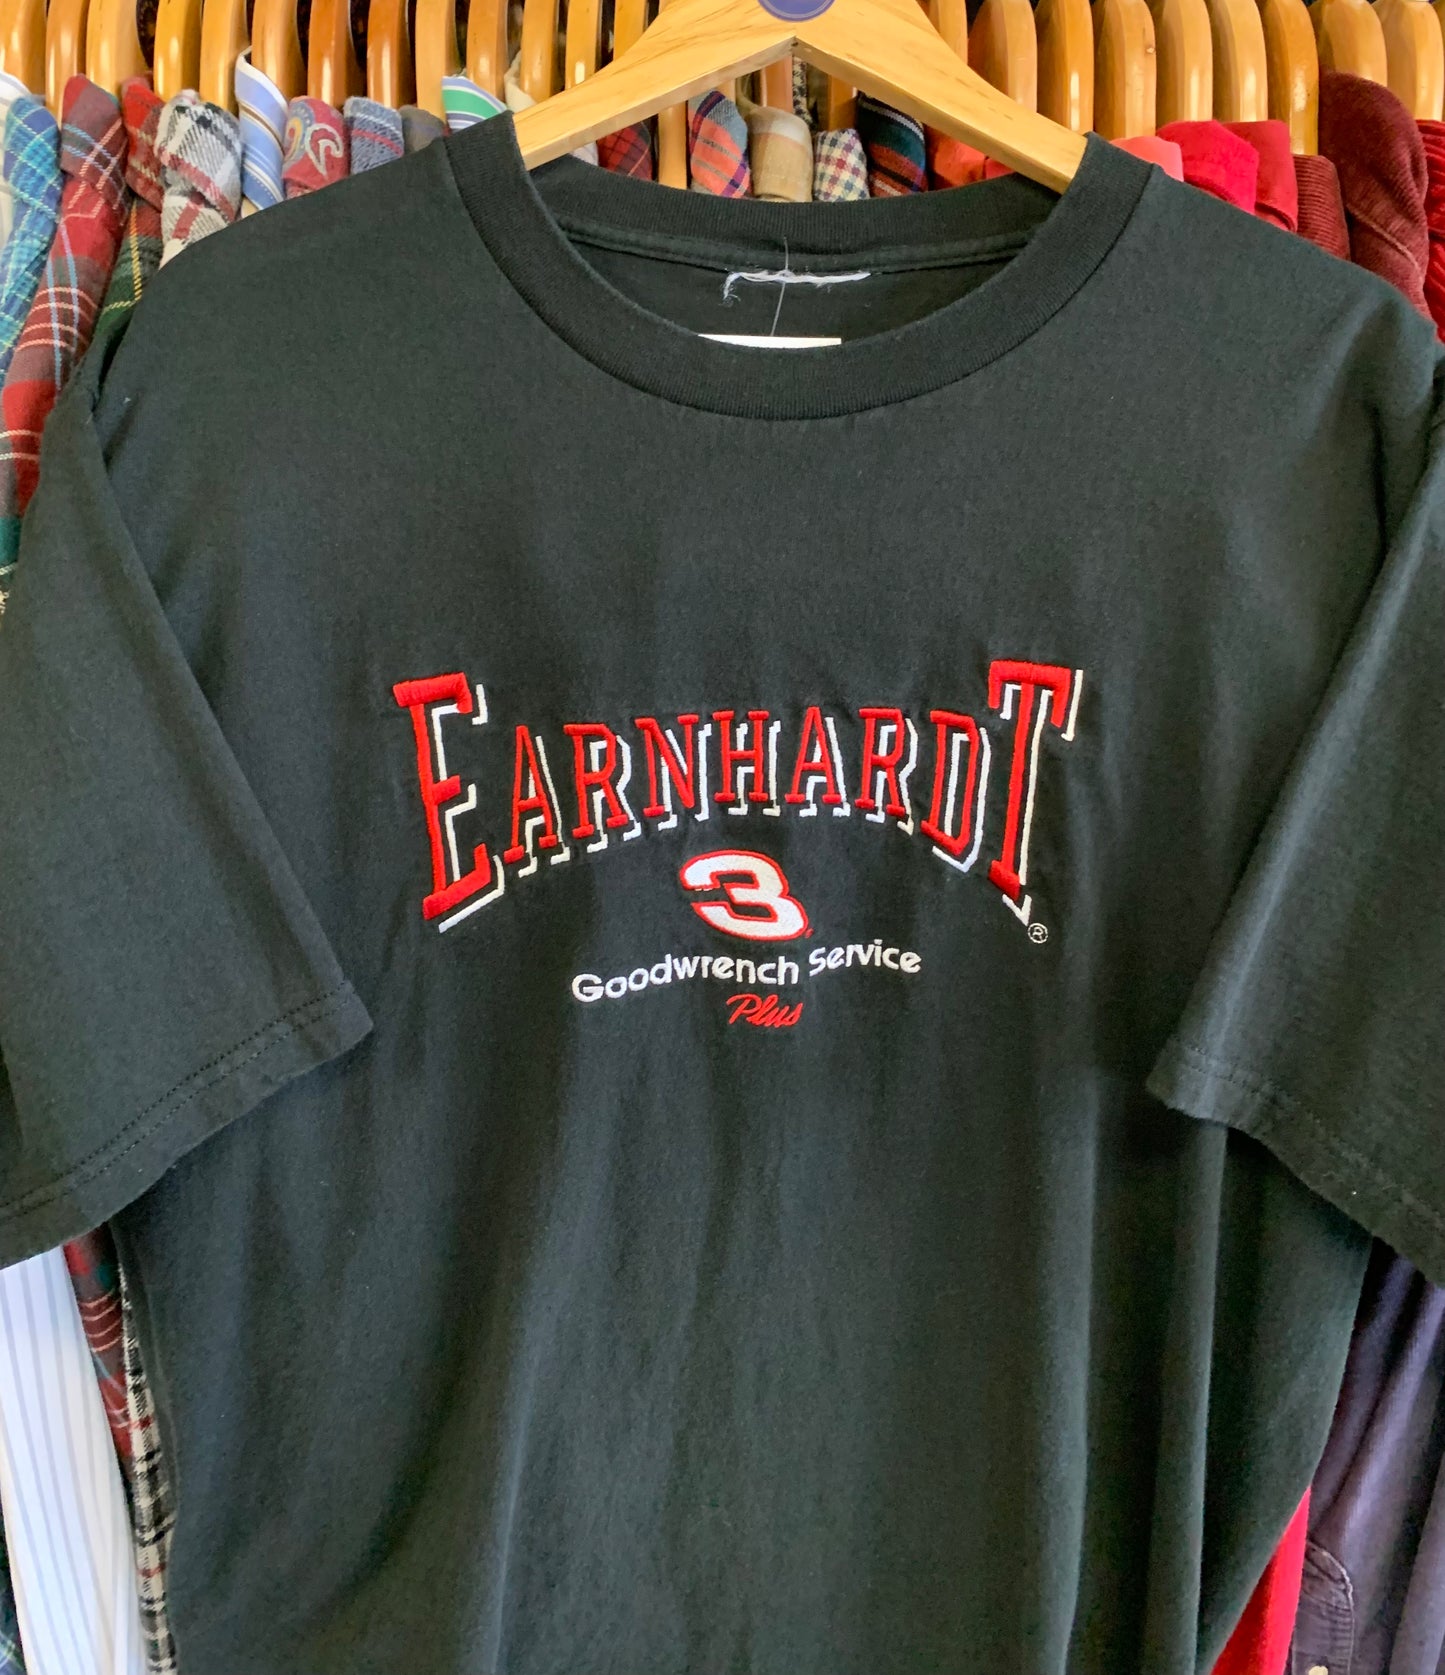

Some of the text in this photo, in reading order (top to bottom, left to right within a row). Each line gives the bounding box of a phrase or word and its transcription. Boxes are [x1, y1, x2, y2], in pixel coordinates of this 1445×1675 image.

[393, 660, 1083, 933] EARNHARDT
[679, 849, 809, 941] 3
[571, 954, 800, 1003] Goodwrench
[725, 993, 804, 1028] Plus
